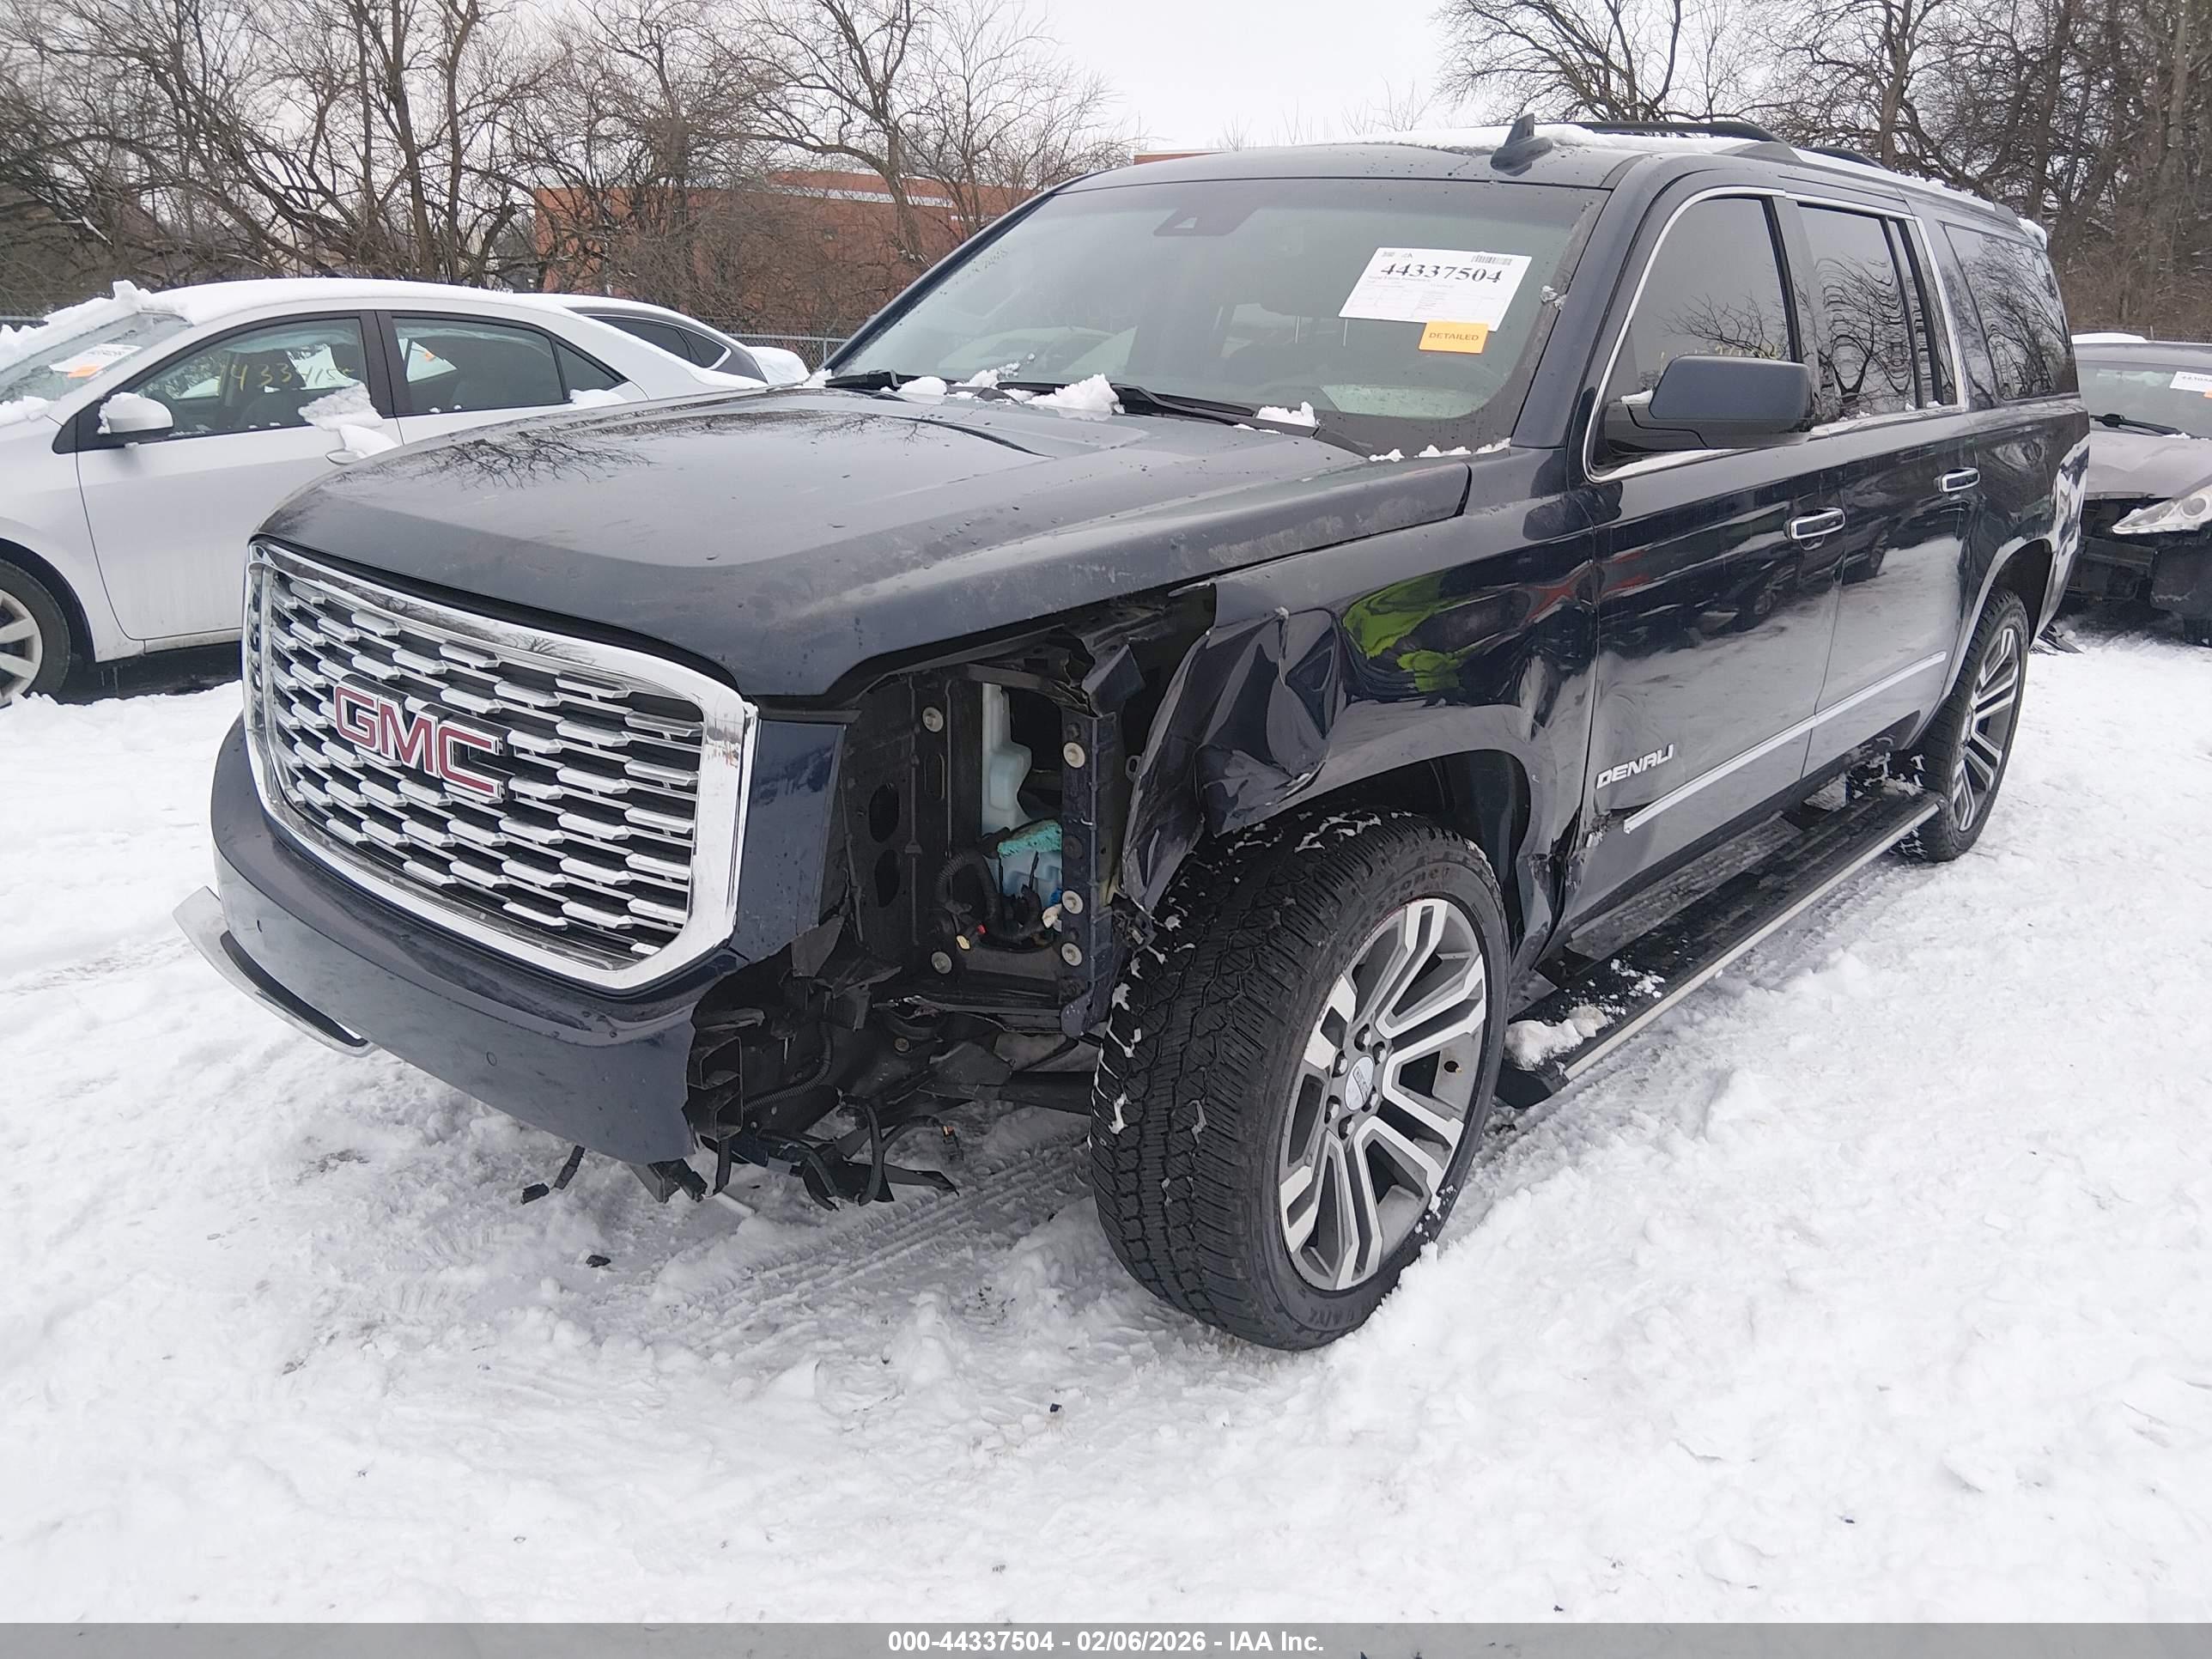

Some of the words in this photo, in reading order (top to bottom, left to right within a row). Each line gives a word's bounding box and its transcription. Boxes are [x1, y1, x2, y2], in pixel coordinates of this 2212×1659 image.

[1380, 262, 1504, 283] 44337504
[1429, 331, 1480, 342] DETAILED
[334, 678, 503, 799] GMC
[1595, 743, 1674, 790] DENALI
